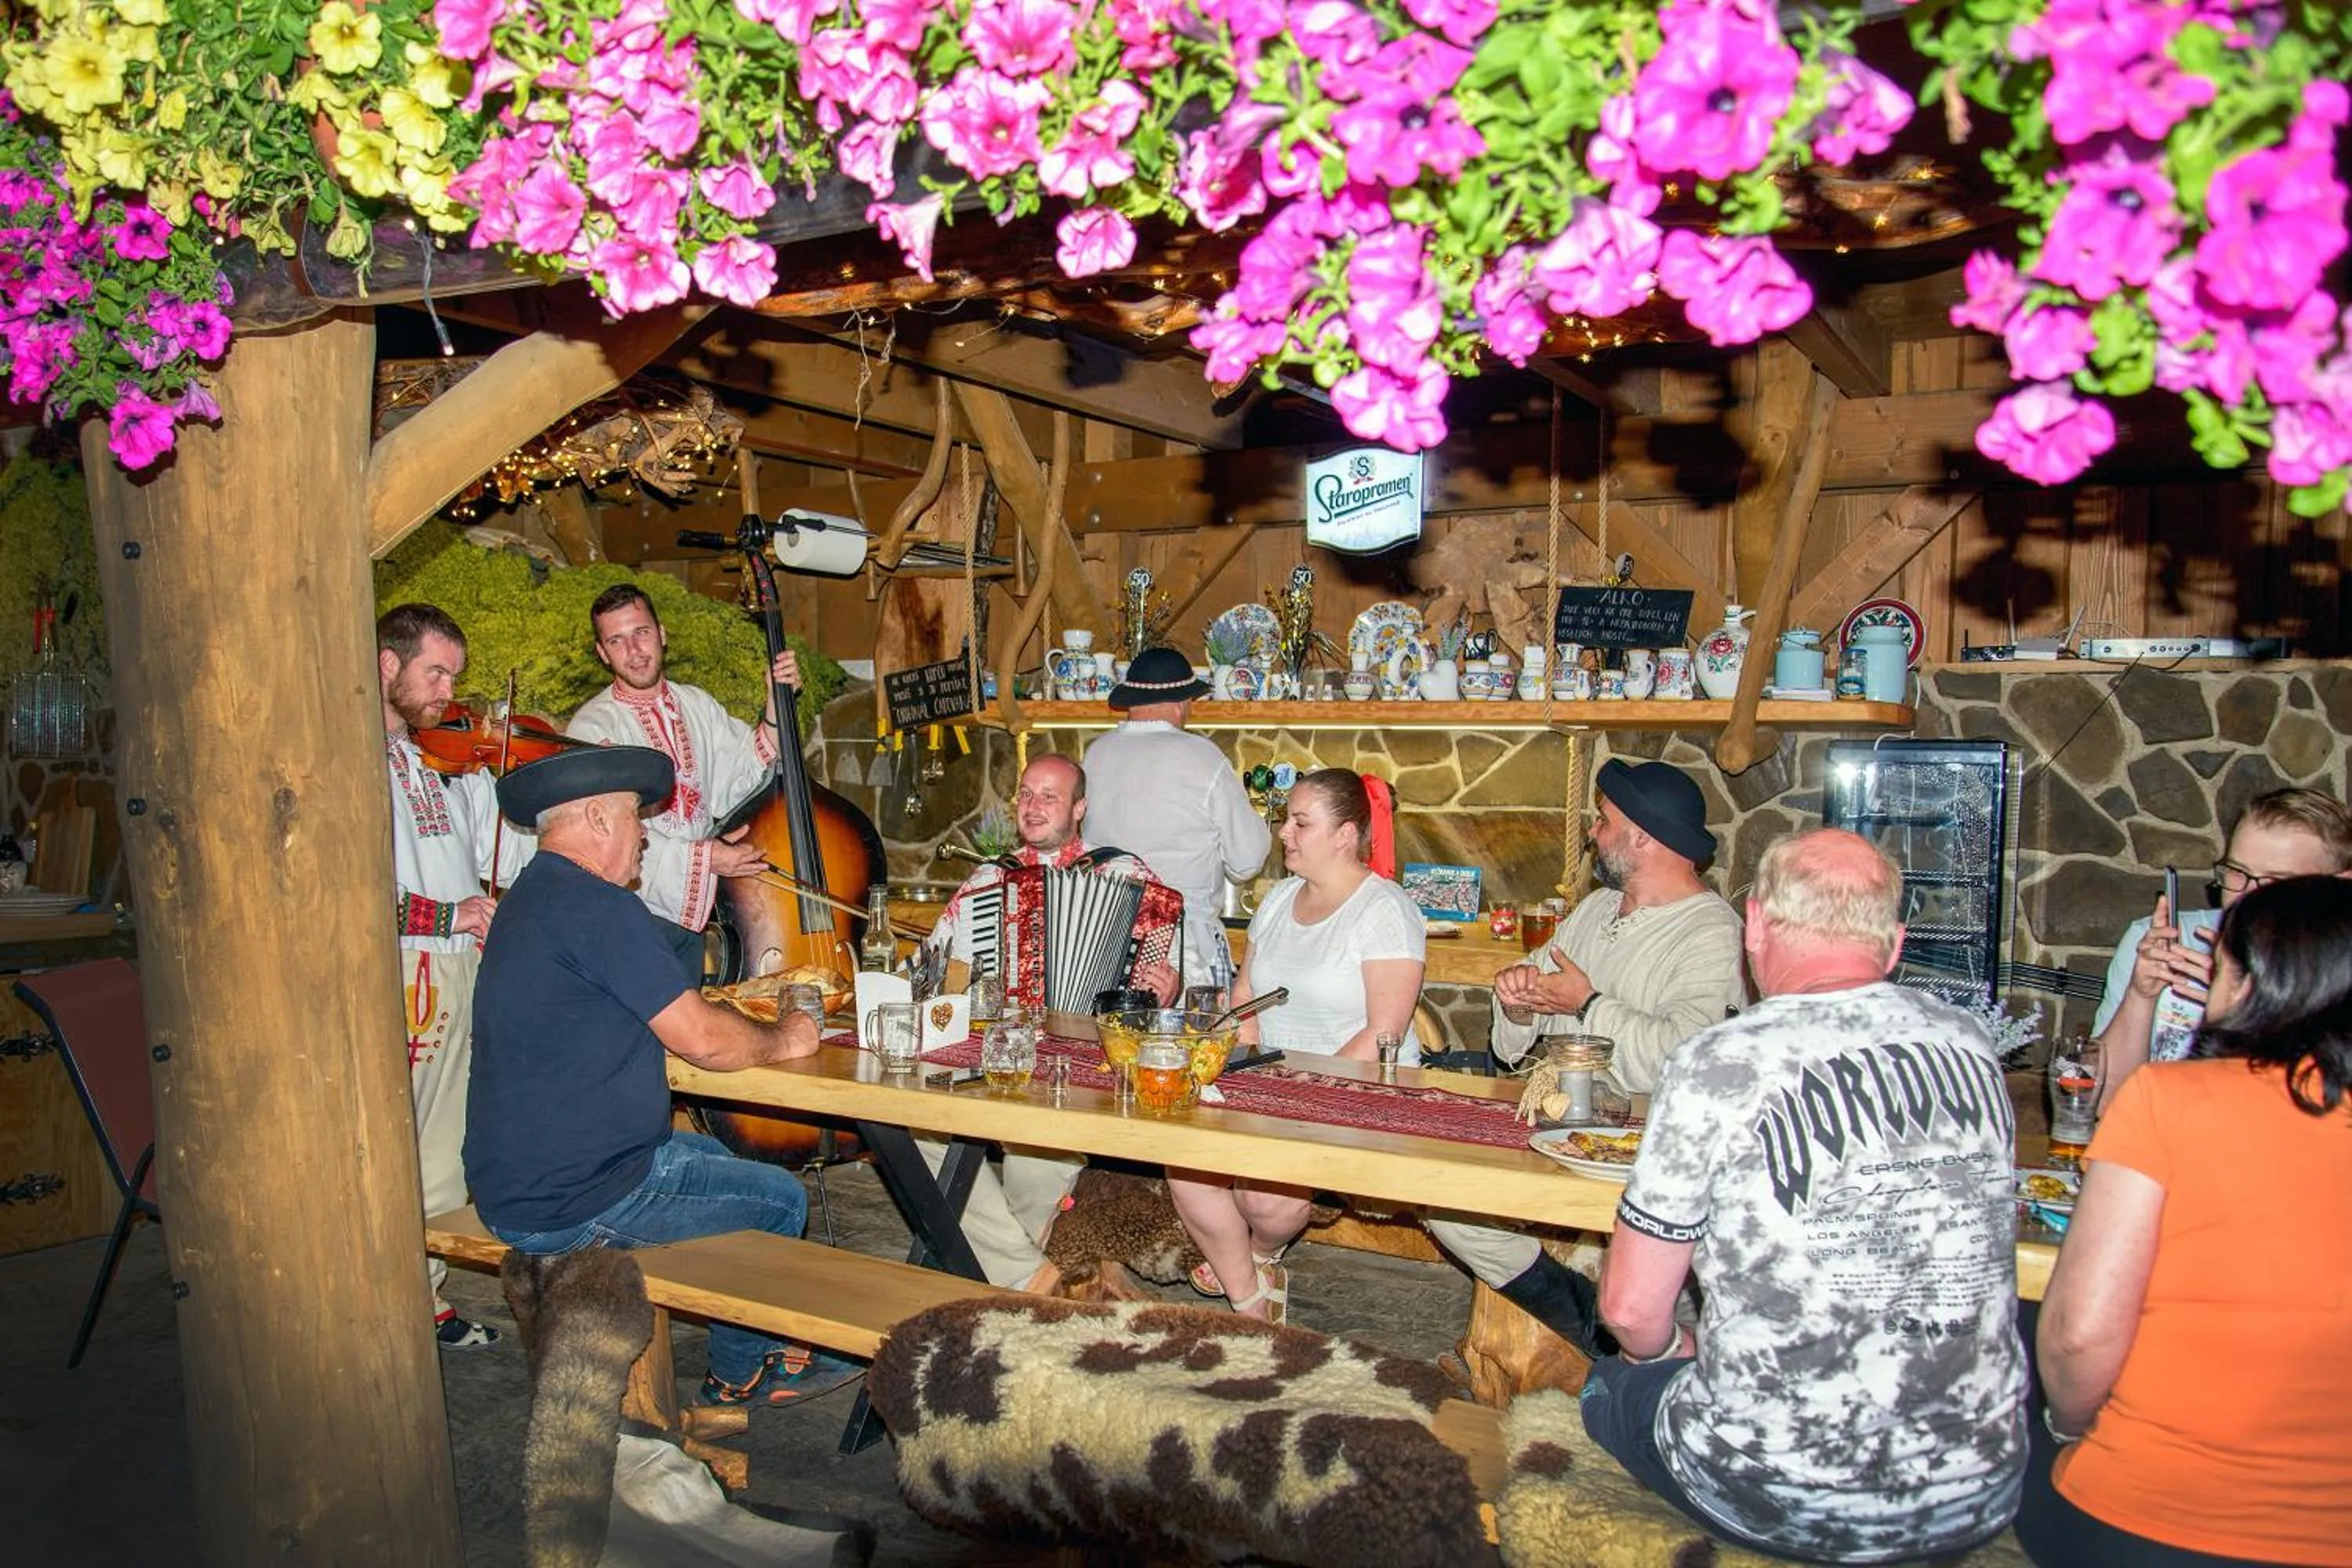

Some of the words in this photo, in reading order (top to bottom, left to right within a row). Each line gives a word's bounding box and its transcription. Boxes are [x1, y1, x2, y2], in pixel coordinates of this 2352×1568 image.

[1315, 474, 1414, 523] Staropramen
[1600, 590, 1644, 606] ALKO
[1802, 1215, 1849, 1225] PALM
[1807, 1231, 1840, 1241] LOS
[1811, 1247, 1857, 1256] LONG
